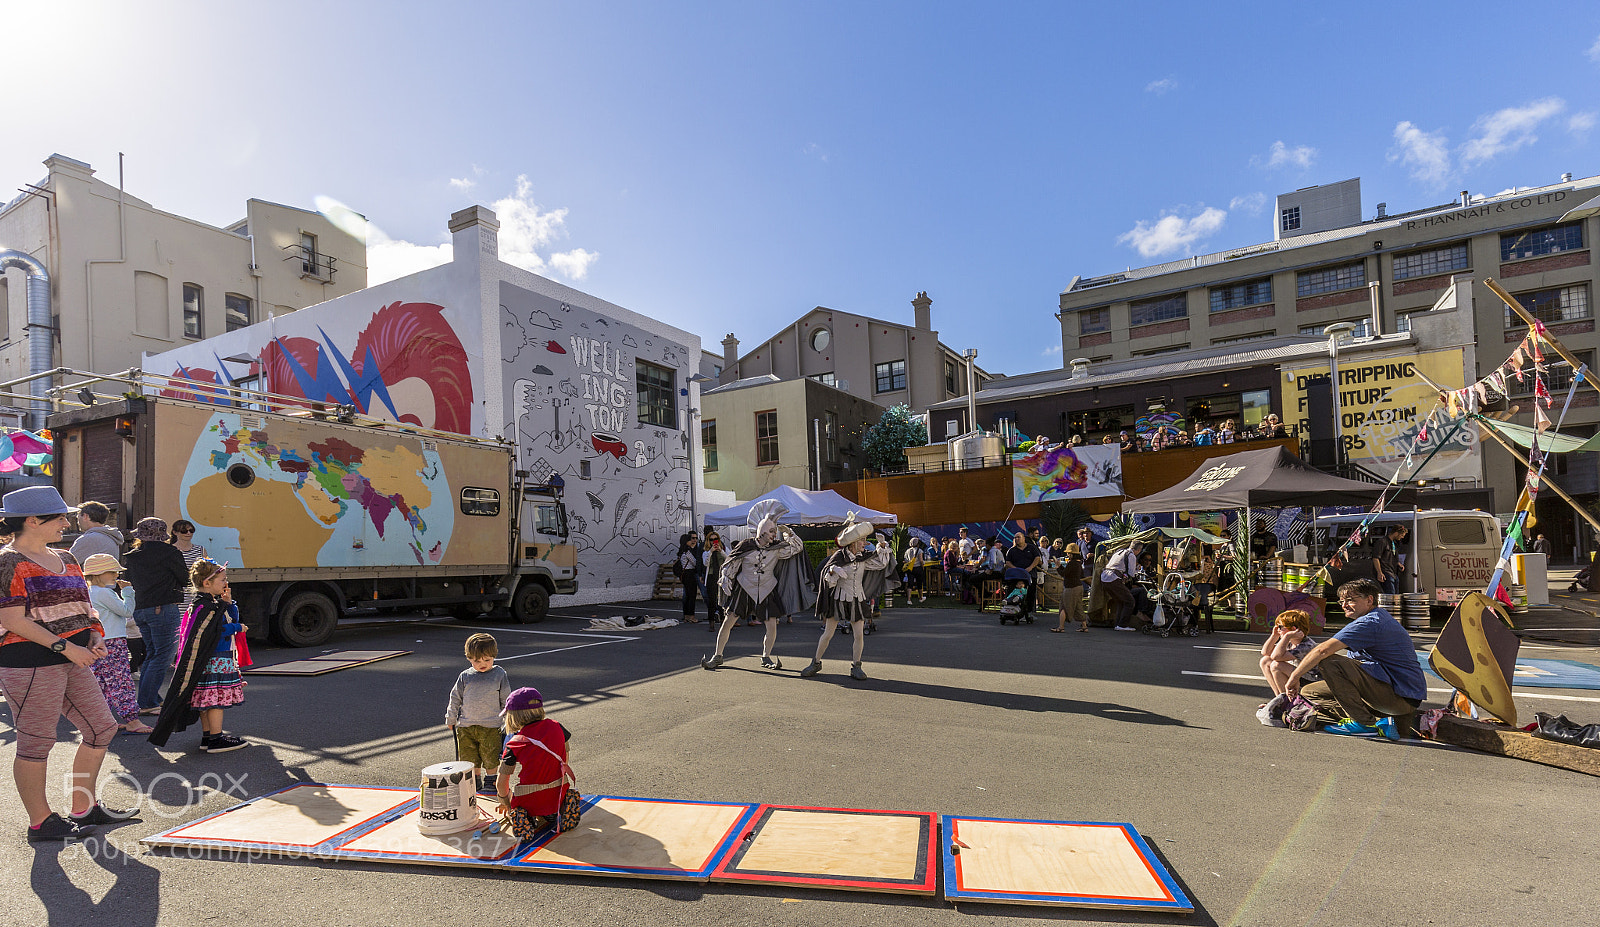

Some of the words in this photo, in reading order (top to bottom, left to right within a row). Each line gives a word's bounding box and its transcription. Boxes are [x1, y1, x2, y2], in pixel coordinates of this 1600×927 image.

[1407, 221, 1420, 230] R.
[1424, 207, 1490, 227] HANNAH
[1496, 204, 1505, 213] &
[1510, 198, 1532, 210] CO
[1537, 191, 1566, 205] LTD
[570, 335, 628, 382] WELL
[580, 373, 626, 408] ING
[1298, 387, 1393, 412] FITURE
[584, 403, 624, 433] TON
[1299, 407, 1417, 433] RORATION
[1441, 551, 1489, 569] FORTUNE
[1451, 569, 1492, 584] FAVOURS
